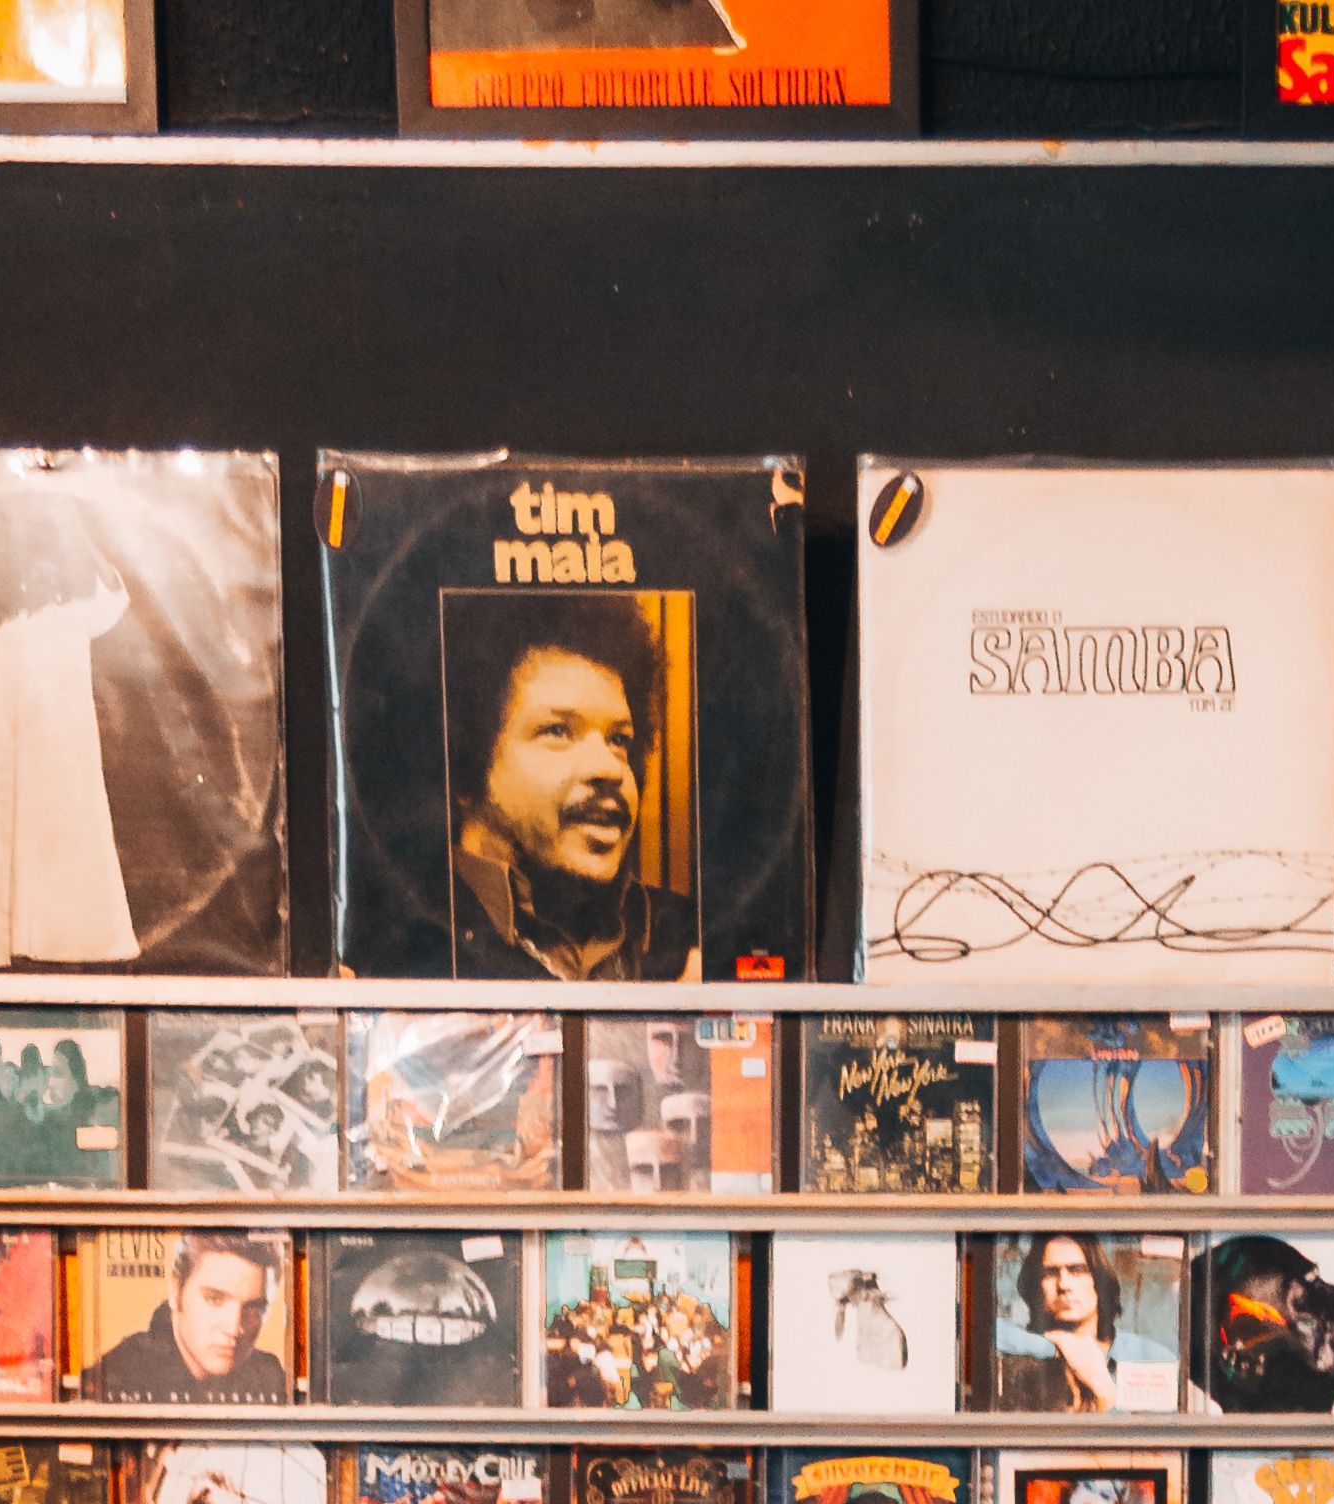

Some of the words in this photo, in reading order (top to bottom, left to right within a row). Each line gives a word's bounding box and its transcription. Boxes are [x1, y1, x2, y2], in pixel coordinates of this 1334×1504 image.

[509, 481, 616, 535] tim
[493, 529, 636, 584] maia
[969, 626, 1236, 694] SAMBA
